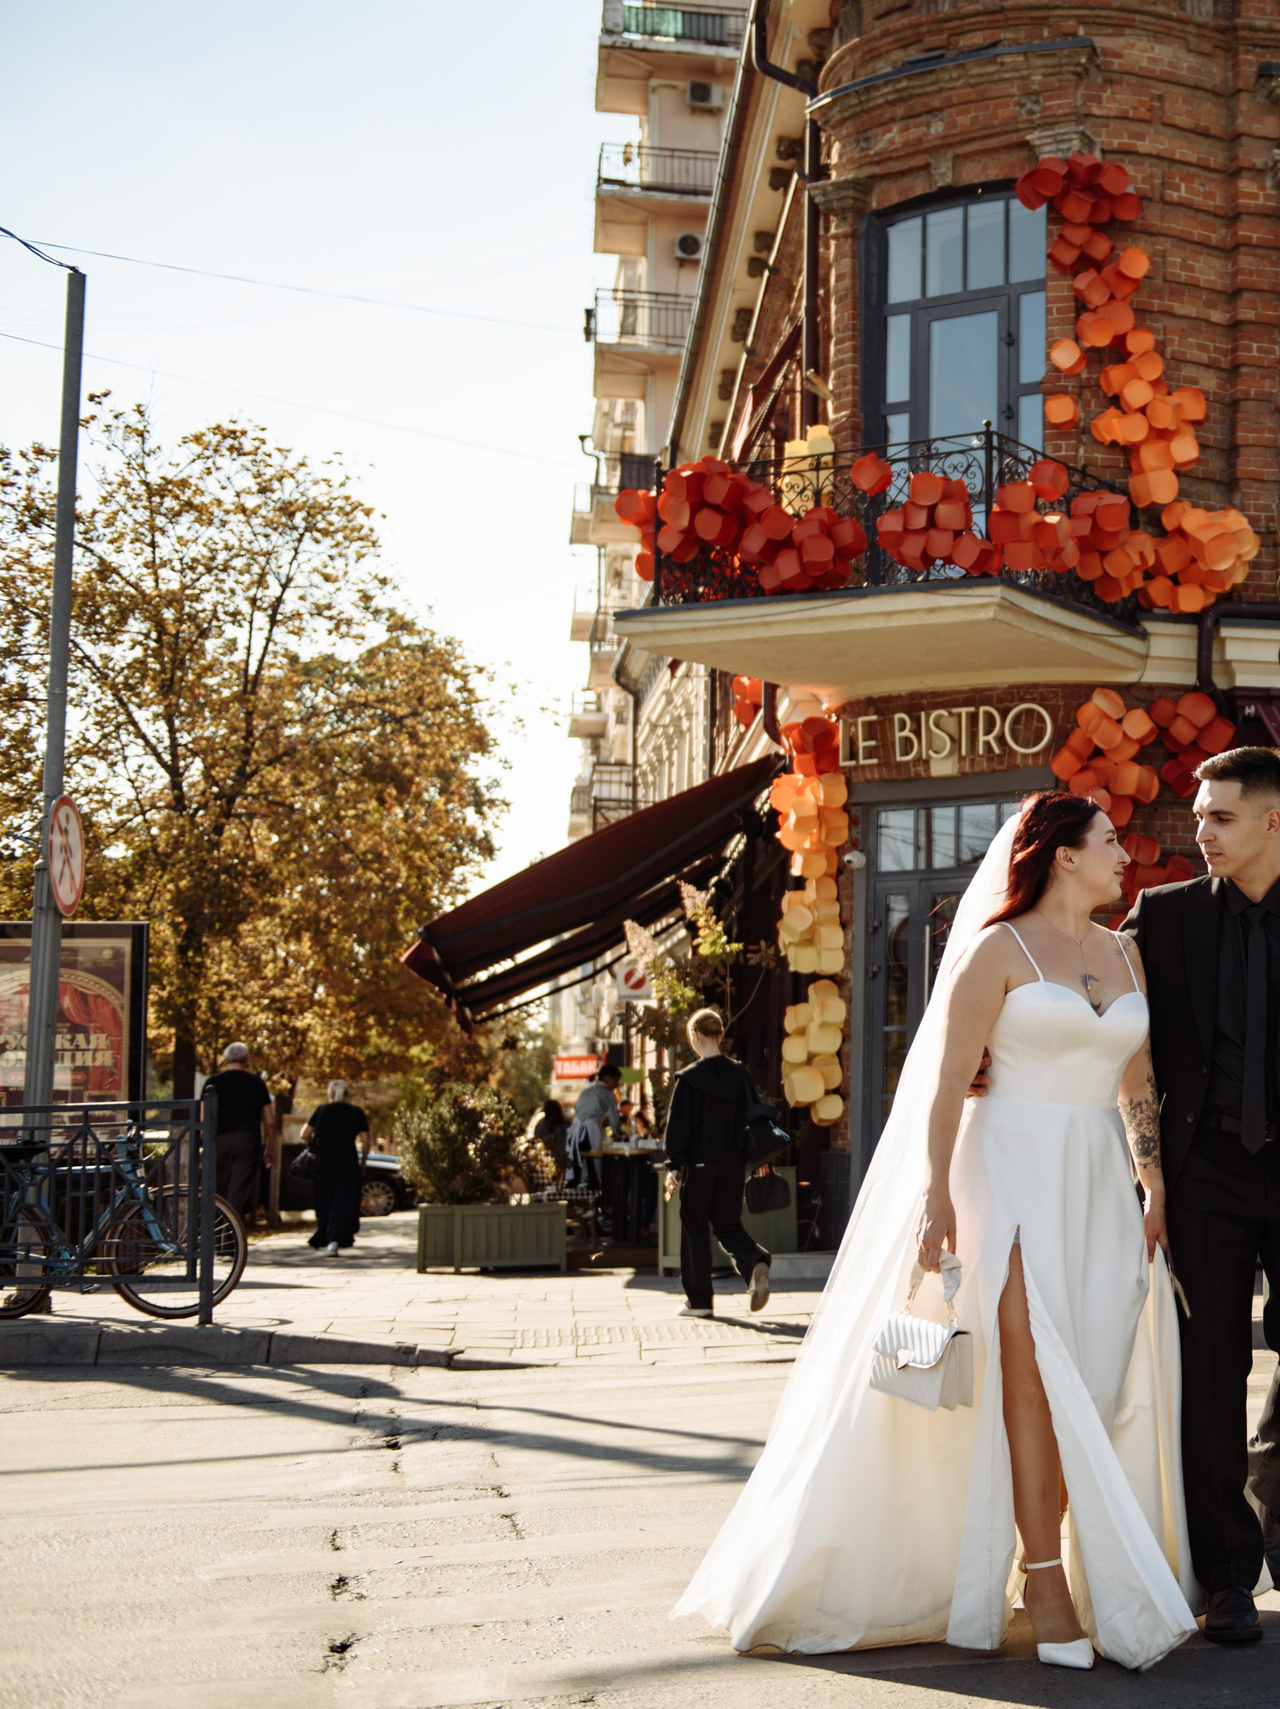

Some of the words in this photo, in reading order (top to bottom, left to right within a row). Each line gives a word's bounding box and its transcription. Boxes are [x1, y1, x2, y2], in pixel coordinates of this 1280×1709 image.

[839, 714, 879, 766] LE
[894, 703, 1052, 762] BISTRO
[0, 1033, 109, 1049] УКАЯ
